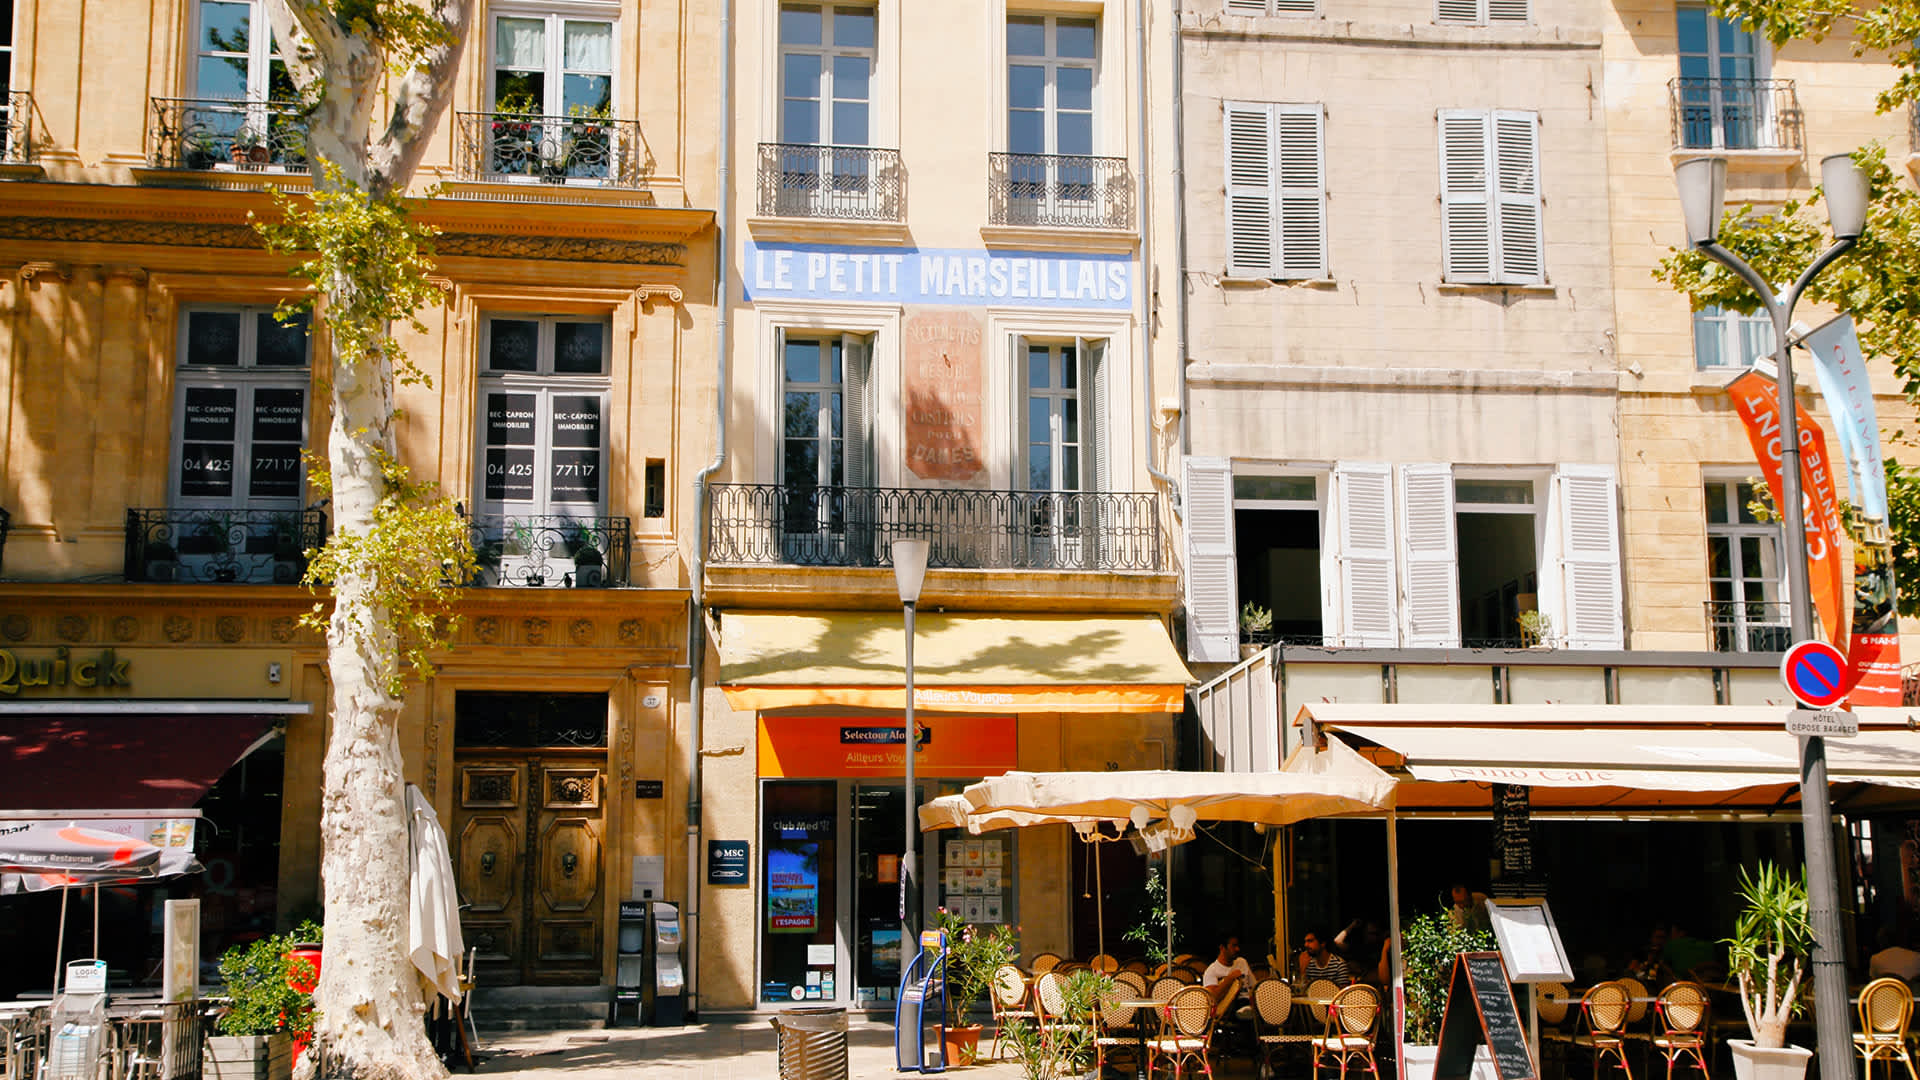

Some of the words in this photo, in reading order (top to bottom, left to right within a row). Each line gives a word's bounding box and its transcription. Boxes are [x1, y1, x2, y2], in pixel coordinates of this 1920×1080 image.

[755, 249, 793, 290] LE
[807, 252, 903, 294] PETIT
[920, 255, 1127, 301] MARSEILLAIS
[911, 445, 975, 464] DAMES
[184, 459, 201, 471] 04
[205, 459, 231, 472] 425
[488, 464, 504, 475] 04
[508, 464, 533, 476] 425
[1806, 451, 1841, 548] CENTRE
[915, 689, 959, 704] Ailleurs
[961, 691, 1014, 706] Voyages
[844, 731, 888, 740] Selectour
[846, 752, 883, 763] Ailleurs
[773, 821, 795, 830] Club
[796, 821, 819, 831] Med
[49, 854, 94, 863] Restaurant
[723, 849, 745, 857] MSC
